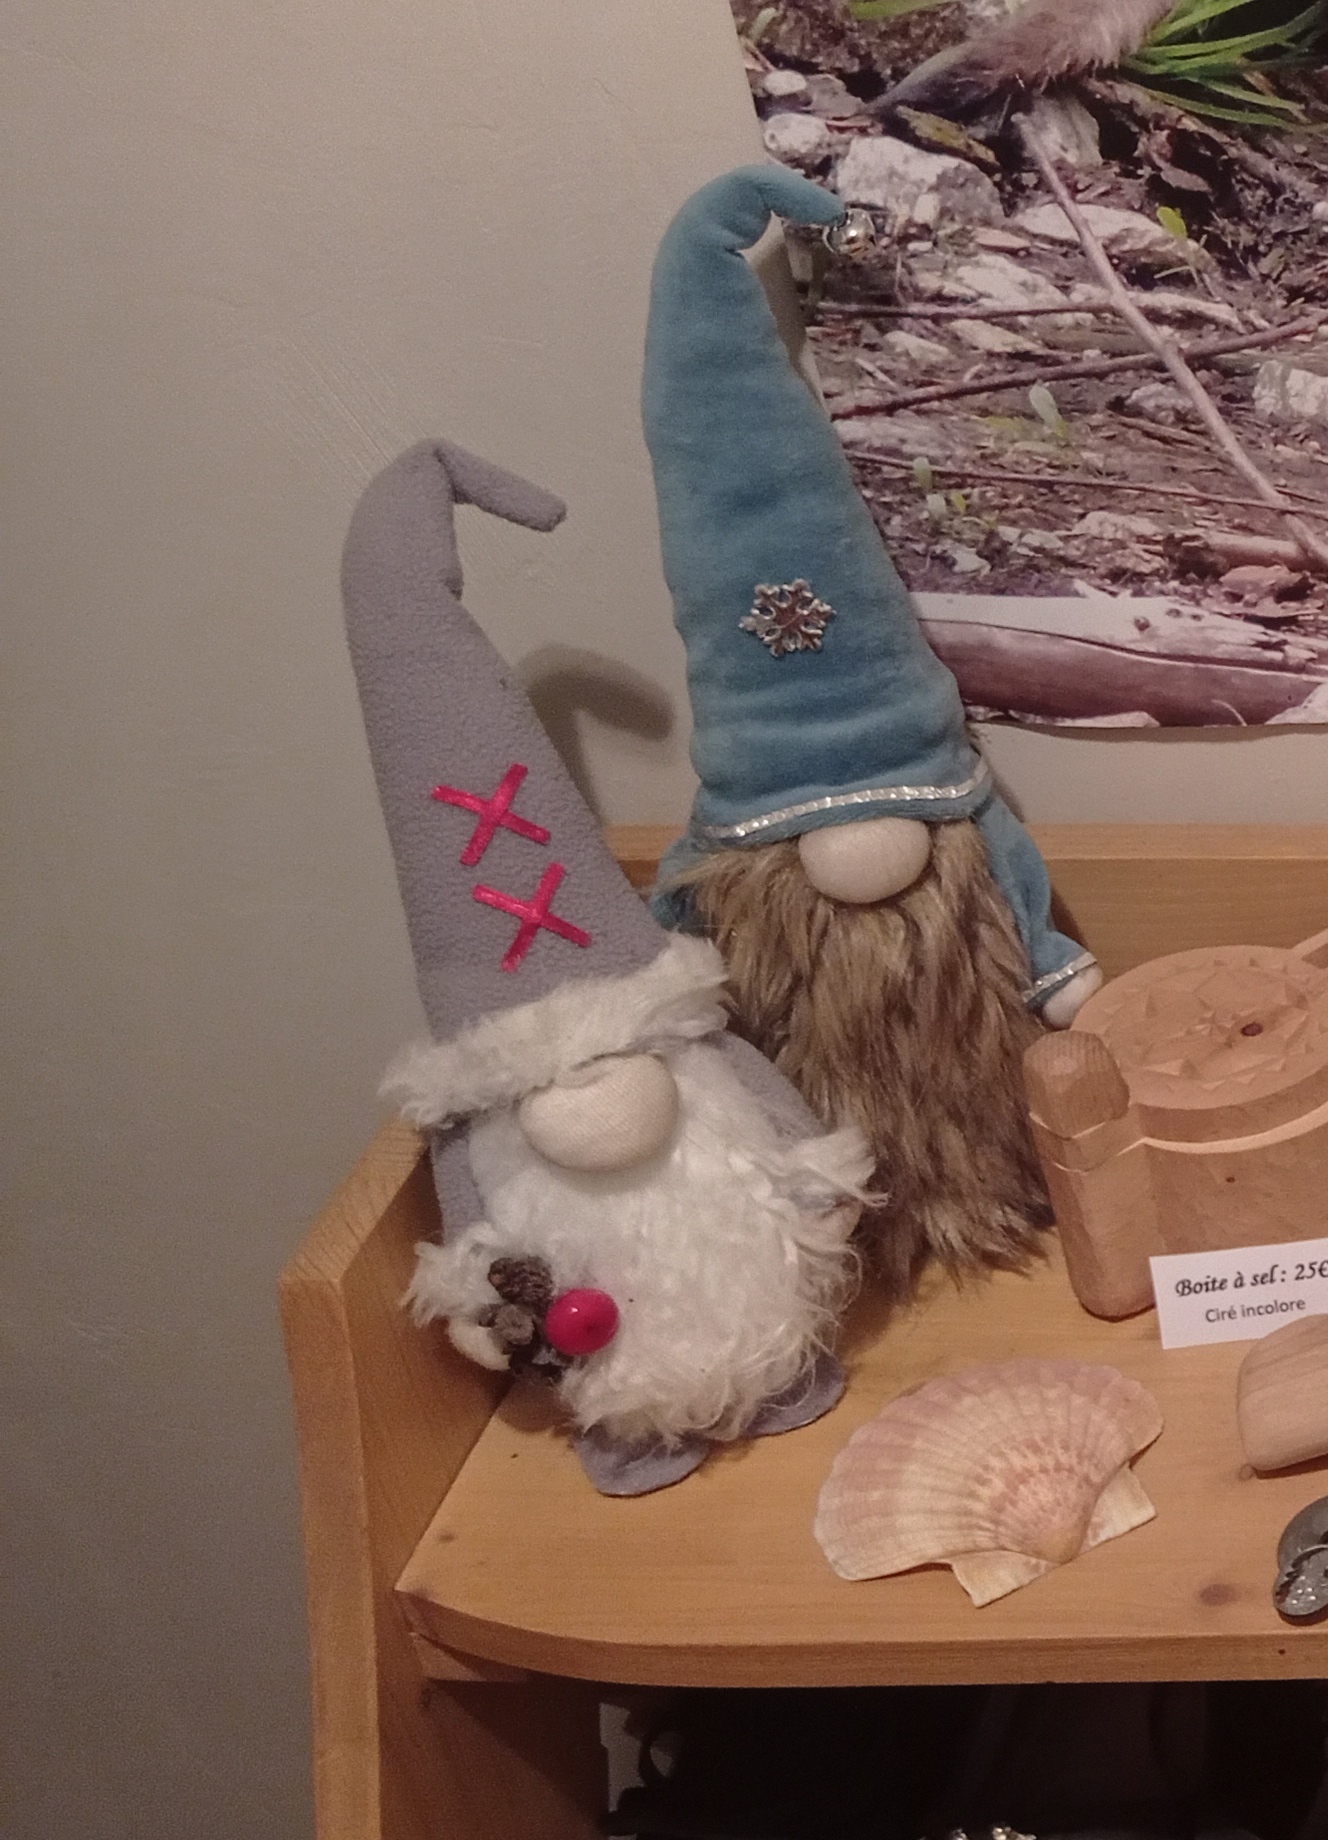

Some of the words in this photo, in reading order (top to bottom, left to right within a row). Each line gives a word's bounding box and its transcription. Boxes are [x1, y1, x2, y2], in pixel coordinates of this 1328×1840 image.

[1175, 1275, 1228, 1297] Boite
[1233, 1271, 1246, 1289] à
[1205, 1305, 1238, 1323] Ciré
[1241, 1297, 1307, 1319] incolore
